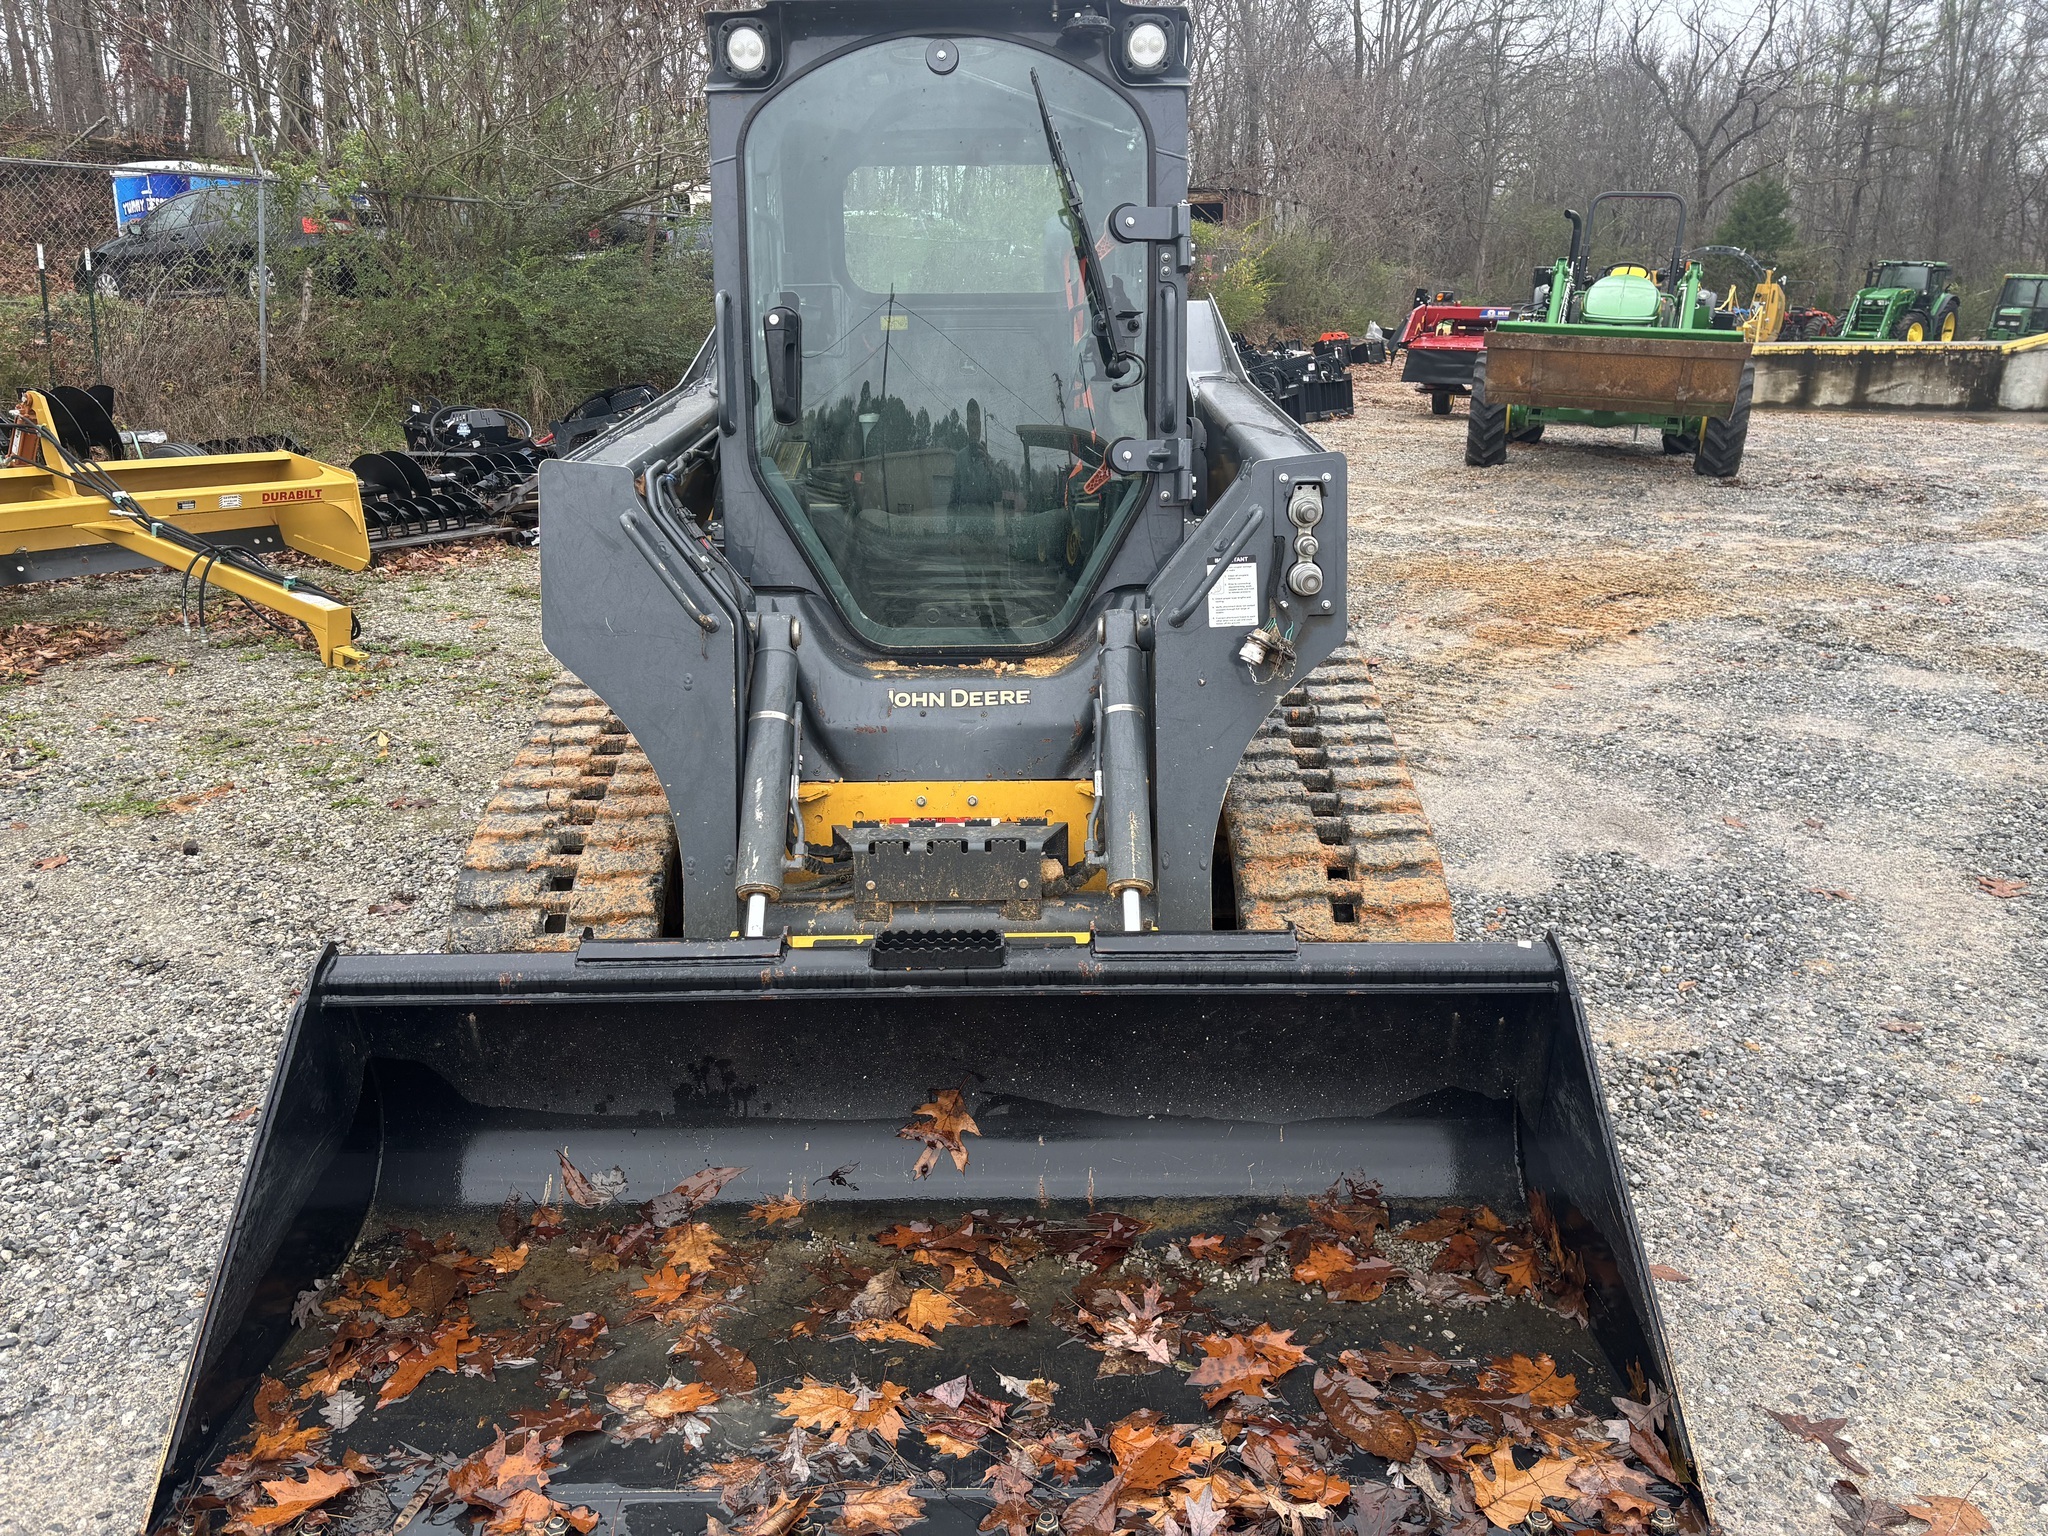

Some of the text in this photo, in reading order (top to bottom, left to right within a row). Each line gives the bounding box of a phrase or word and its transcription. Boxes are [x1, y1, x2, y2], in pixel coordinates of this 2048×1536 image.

[262, 489, 323, 502] DURABILT
[888, 689, 1031, 708] JOHN DEERE
